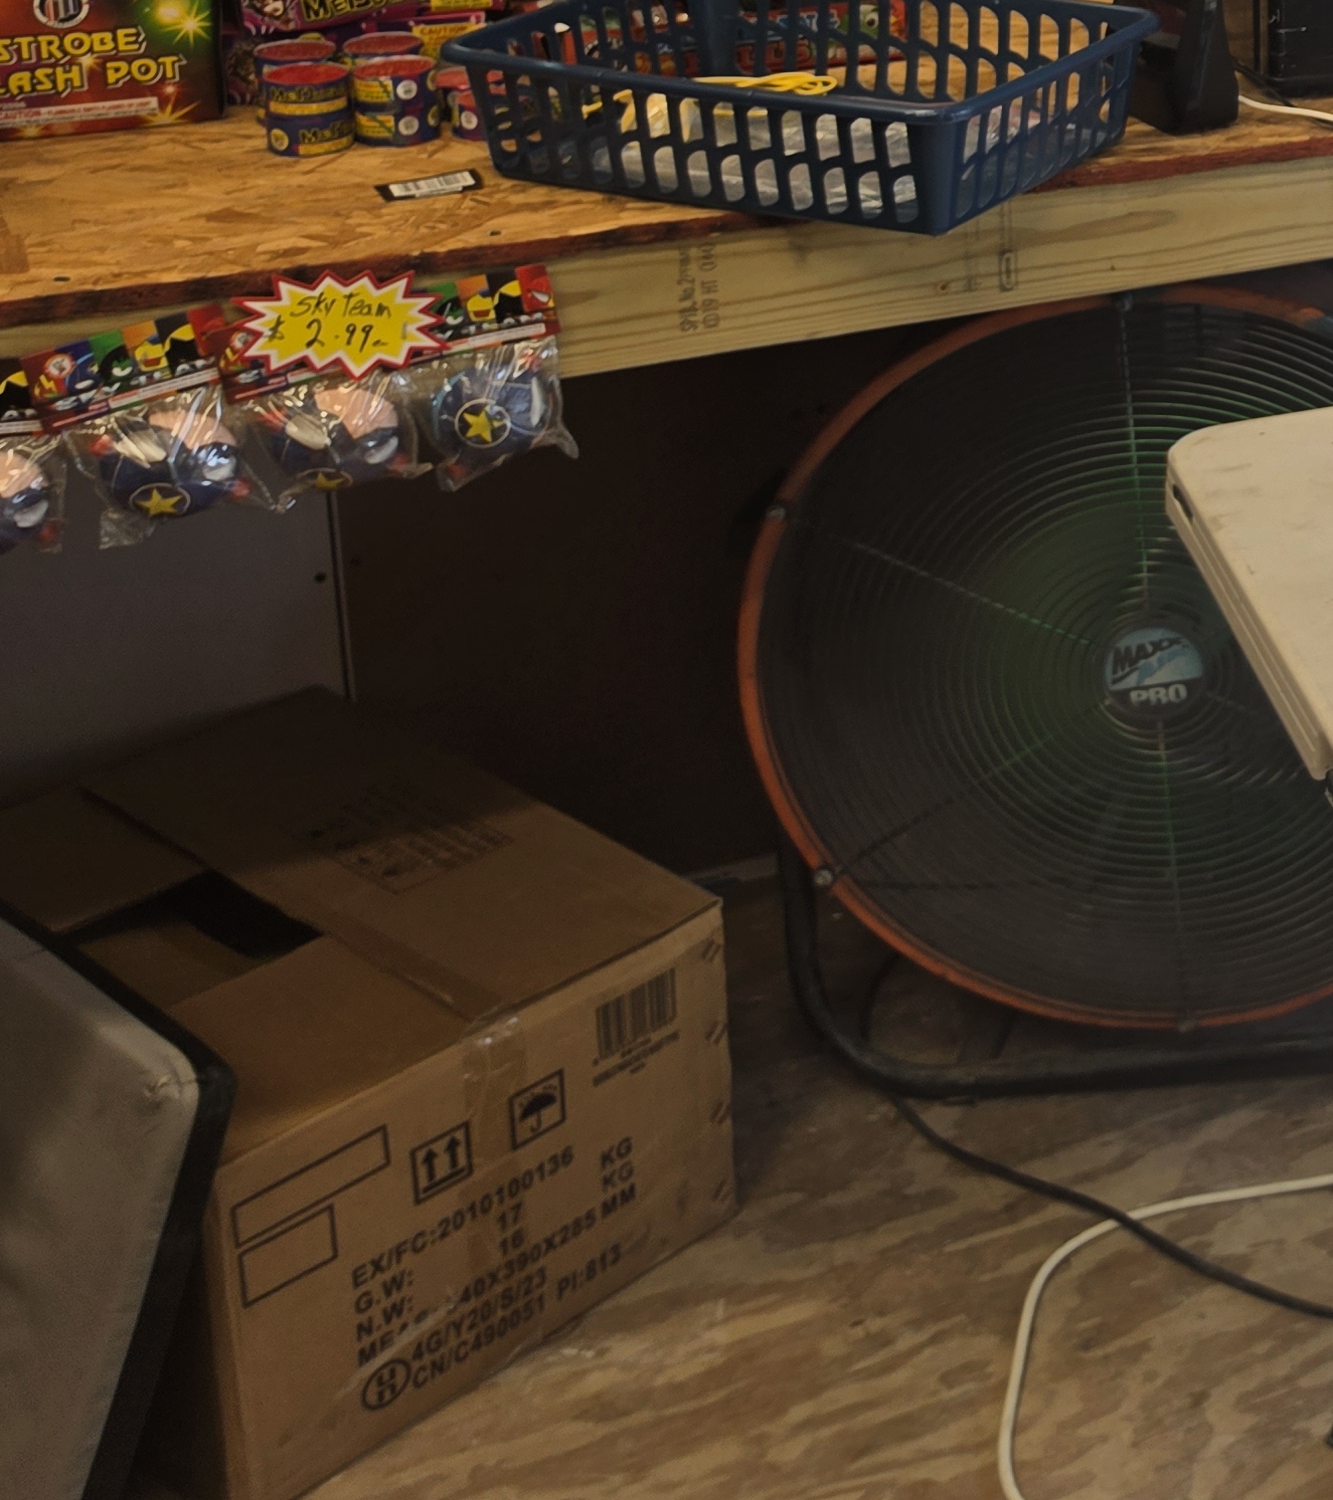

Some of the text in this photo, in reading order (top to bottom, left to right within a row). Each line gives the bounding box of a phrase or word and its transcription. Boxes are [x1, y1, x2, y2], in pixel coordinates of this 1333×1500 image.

[105, 54, 183, 87] POT
[289, 292, 393, 319] Sky Team
[1129, 683, 1188, 706] PRO
[497, 1200, 524, 1232] 17
[600, 1136, 633, 1171] KG
[601, 1160, 635, 1194] KG
[601, 1181, 637, 1220] MM
